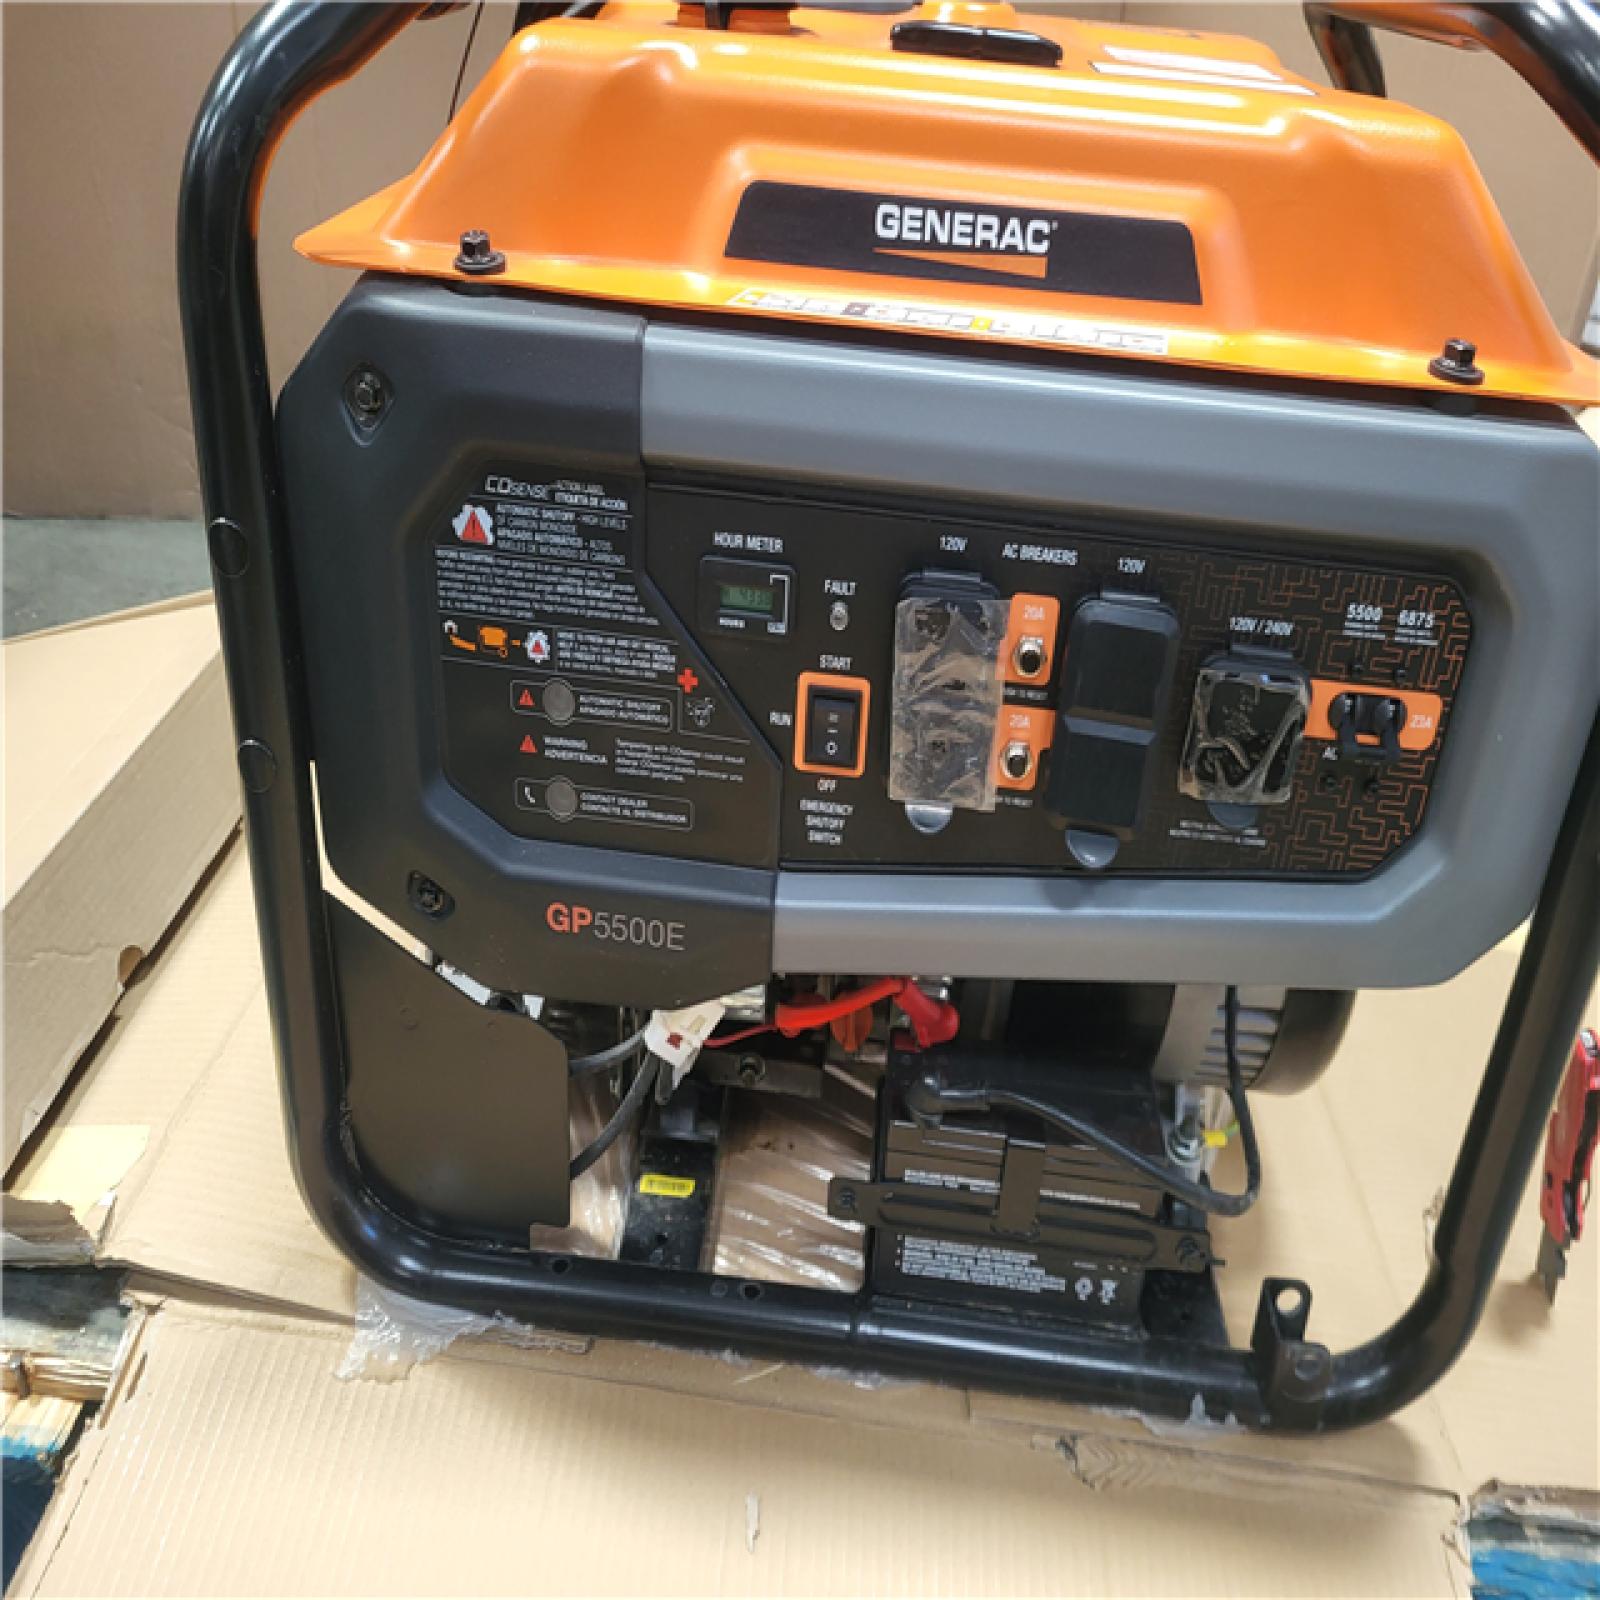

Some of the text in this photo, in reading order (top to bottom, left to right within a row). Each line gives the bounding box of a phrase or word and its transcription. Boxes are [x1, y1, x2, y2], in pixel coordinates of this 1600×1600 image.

[875, 203, 1049, 254] GENERAC
[713, 531, 784, 553] HOUR METER
[939, 535, 968, 552] 120V
[1002, 542, 1079, 566] AC BREAKERS
[1118, 556, 1146, 574] 120V
[824, 579, 857, 596] FAULT
[1023, 605, 1046, 621] 20A
[1347, 602, 1383, 621] 5500
[1398, 609, 1436, 628] 6875
[819, 653, 852, 671] START
[768, 710, 792, 727] RUN
[1009, 714, 1031, 729] 20A
[817, 778, 838, 793] OFF
[800, 799, 854, 816] EMERGENCY
[806, 815, 846, 831] SHUTOFF
[808, 830, 843, 845] SWITCH
[545, 901, 687, 950] GP5500E
